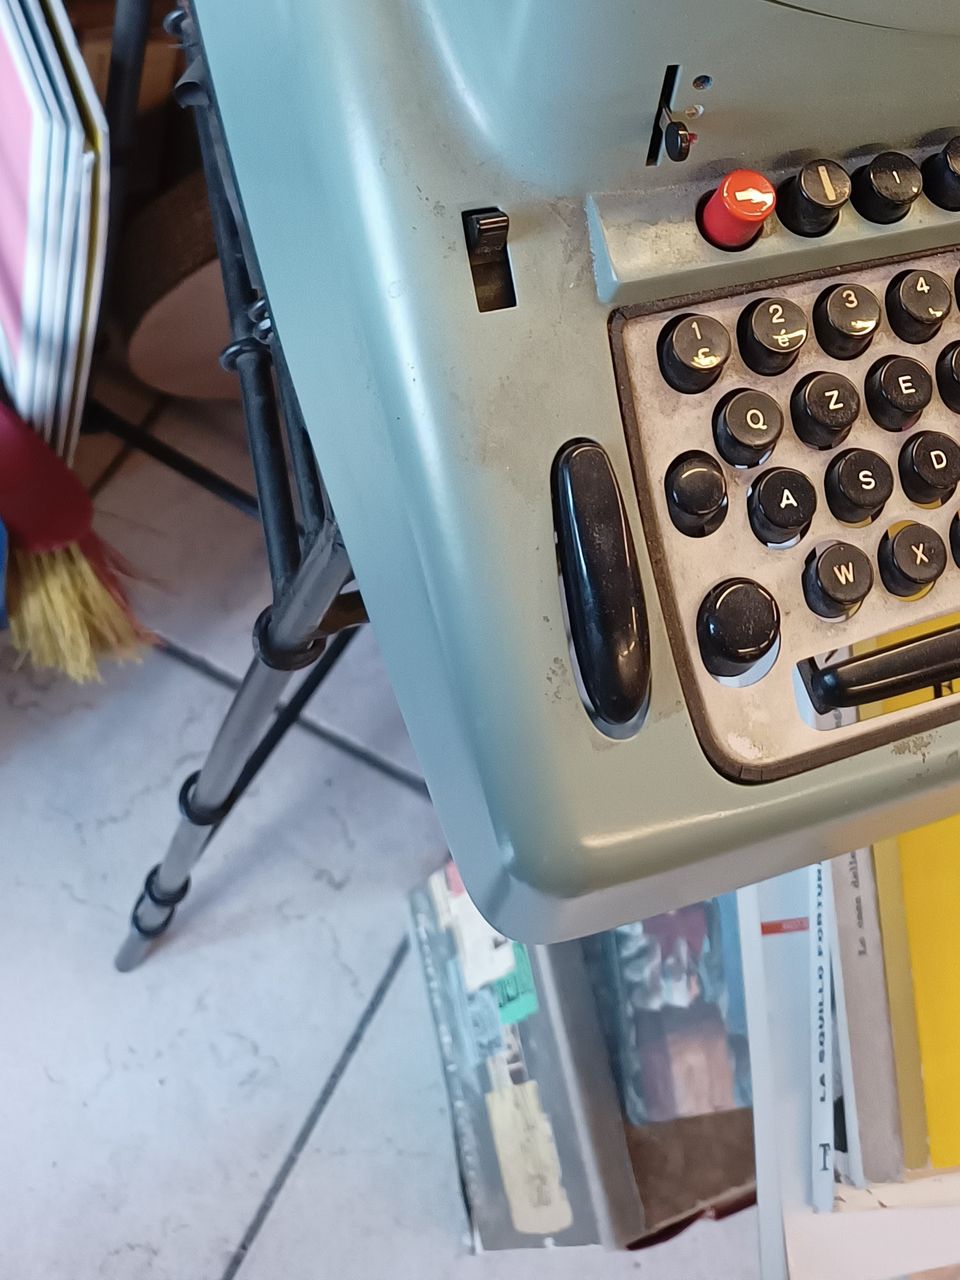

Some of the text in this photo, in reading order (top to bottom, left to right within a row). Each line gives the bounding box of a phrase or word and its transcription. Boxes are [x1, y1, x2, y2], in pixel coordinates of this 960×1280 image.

[691, 321, 702, 340] 1
[769, 305, 784, 324] 2
[842, 291, 858, 308] 3
[916, 277, 930, 294] 4
[746, 408, 767, 431] Q
[825, 390, 845, 411] Z
[898, 375, 916, 395] E
[779, 488, 798, 509] A
[858, 470, 876, 491] S
[930, 449, 947, 471] D
[833, 561, 855, 586] W
[911, 543, 929, 565] X
[815, 861, 825, 958] FORTUN
[817, 965, 826, 1064] SQUILLO
